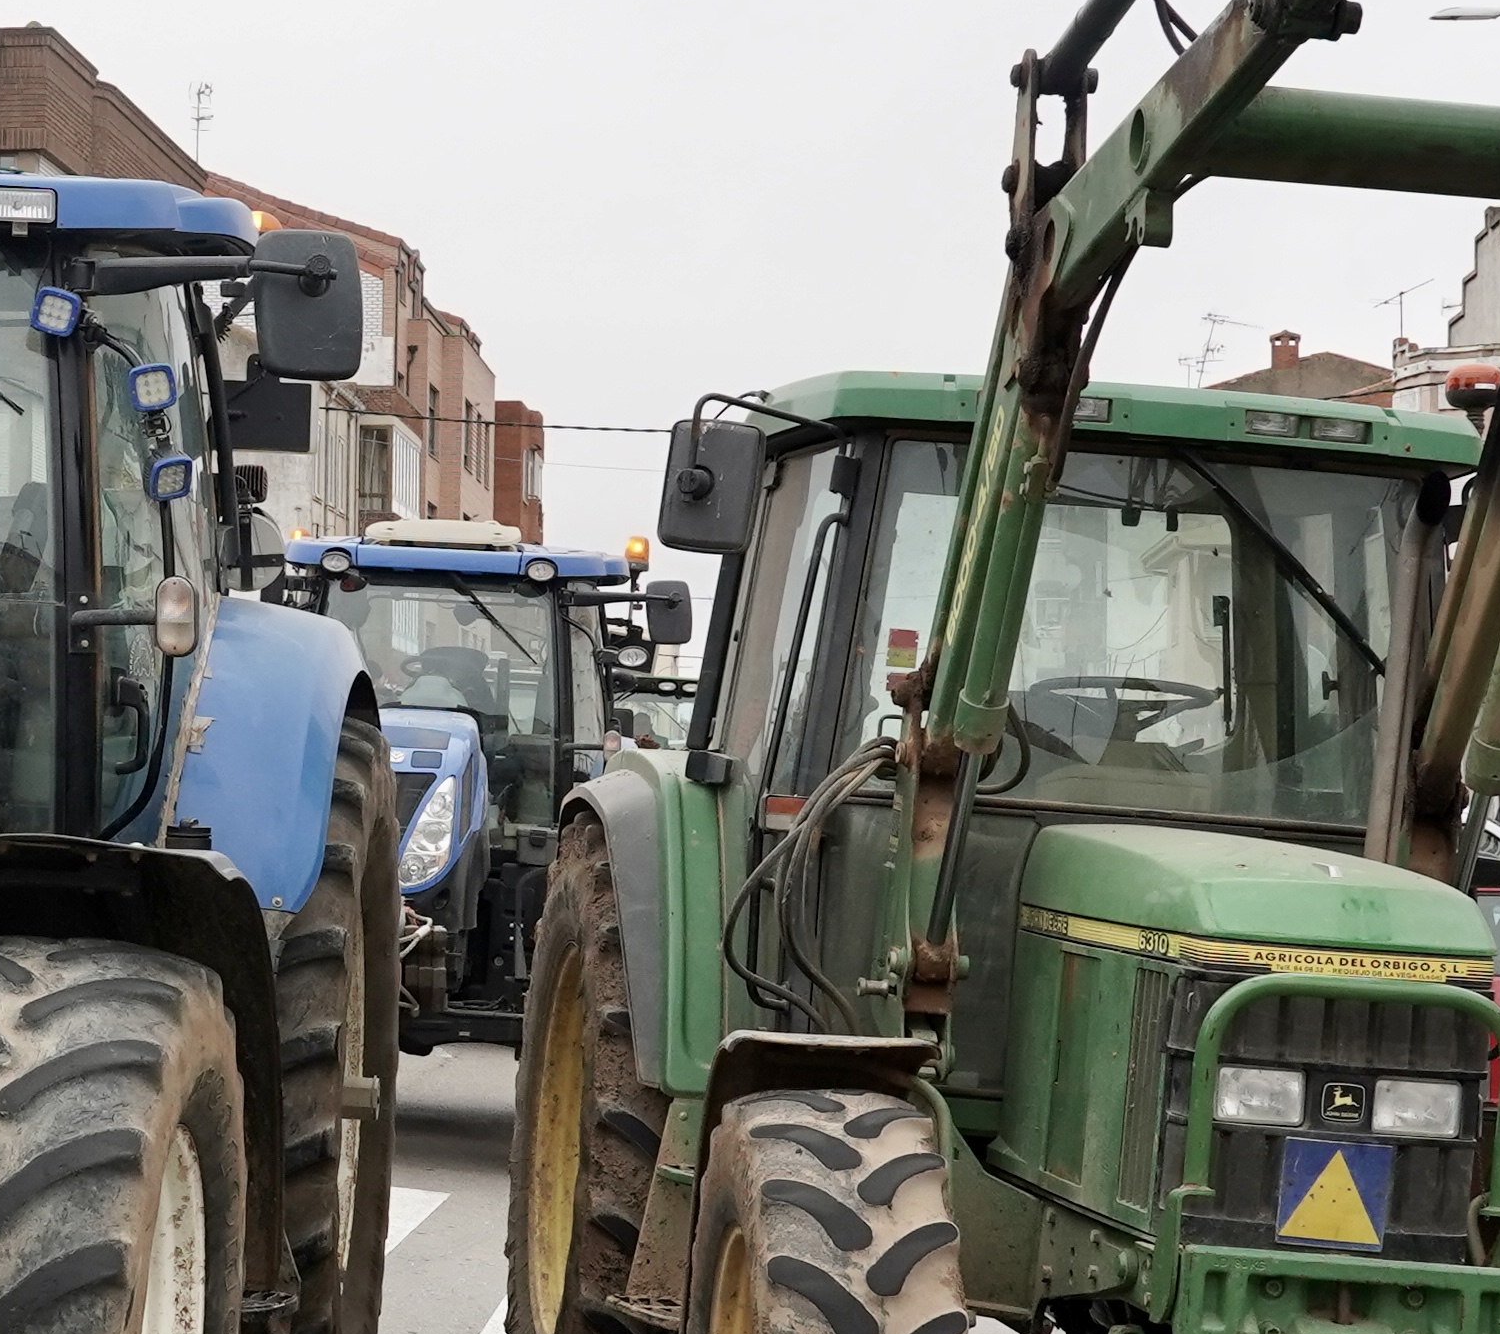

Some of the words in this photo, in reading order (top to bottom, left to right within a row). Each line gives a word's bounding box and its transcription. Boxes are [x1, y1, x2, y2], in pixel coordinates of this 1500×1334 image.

[1138, 930, 1169, 955] 6310
[1253, 950, 1335, 967] AGRICOLA
[1339, 957, 1367, 968] DEL
[1370, 960, 1436, 974] ORBIGO,
